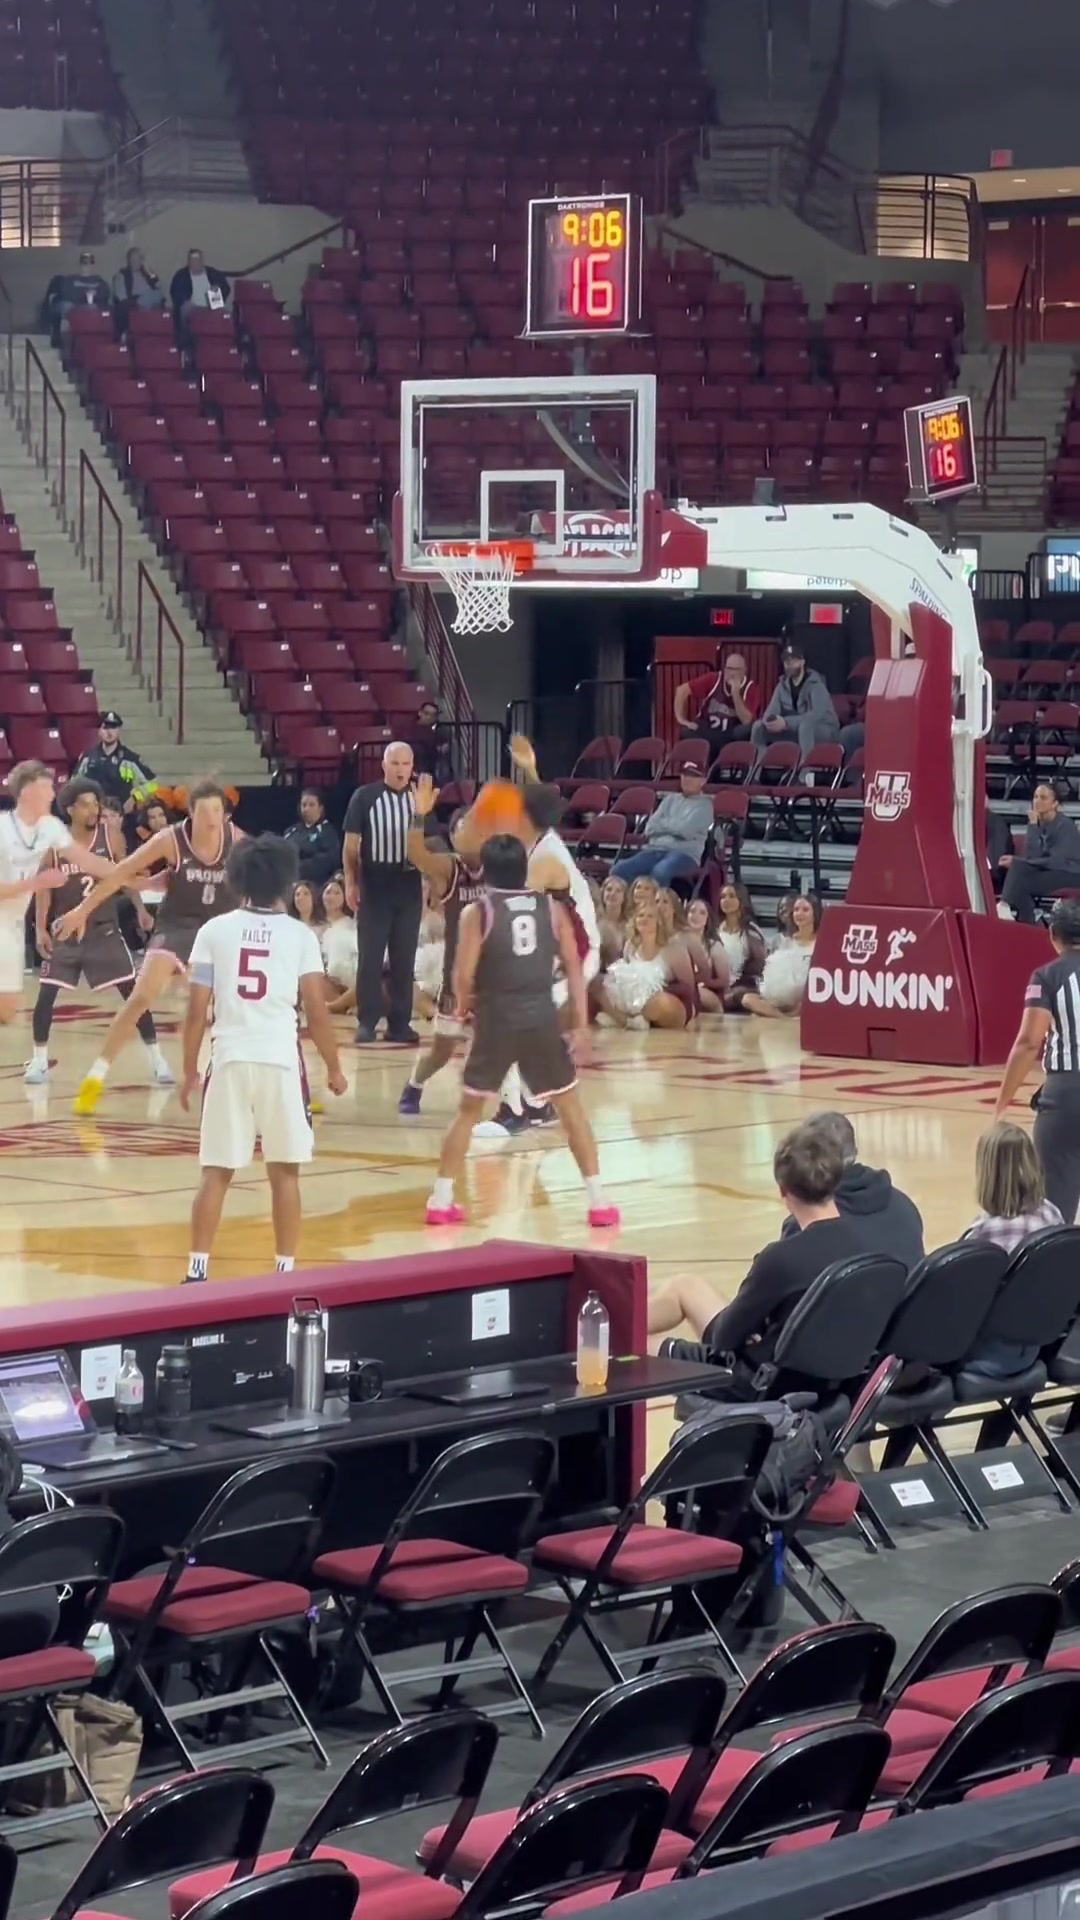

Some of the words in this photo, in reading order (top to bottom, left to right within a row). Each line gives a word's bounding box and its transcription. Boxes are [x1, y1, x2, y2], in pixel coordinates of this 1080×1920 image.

[557, 201, 605, 211] DAKTRONICS
[563, 211, 622, 247] 9:06
[572, 253, 613, 317] 16
[928, 413, 960, 441] 9:06
[936, 443, 956, 477] 16
[909, 577, 947, 619] SPALDING
[241, 928, 273, 943] HAILEY
[512, 915, 537, 956] 8
[237, 947, 270, 1001] 5
[808, 966, 953, 1012] DUNKIN'
